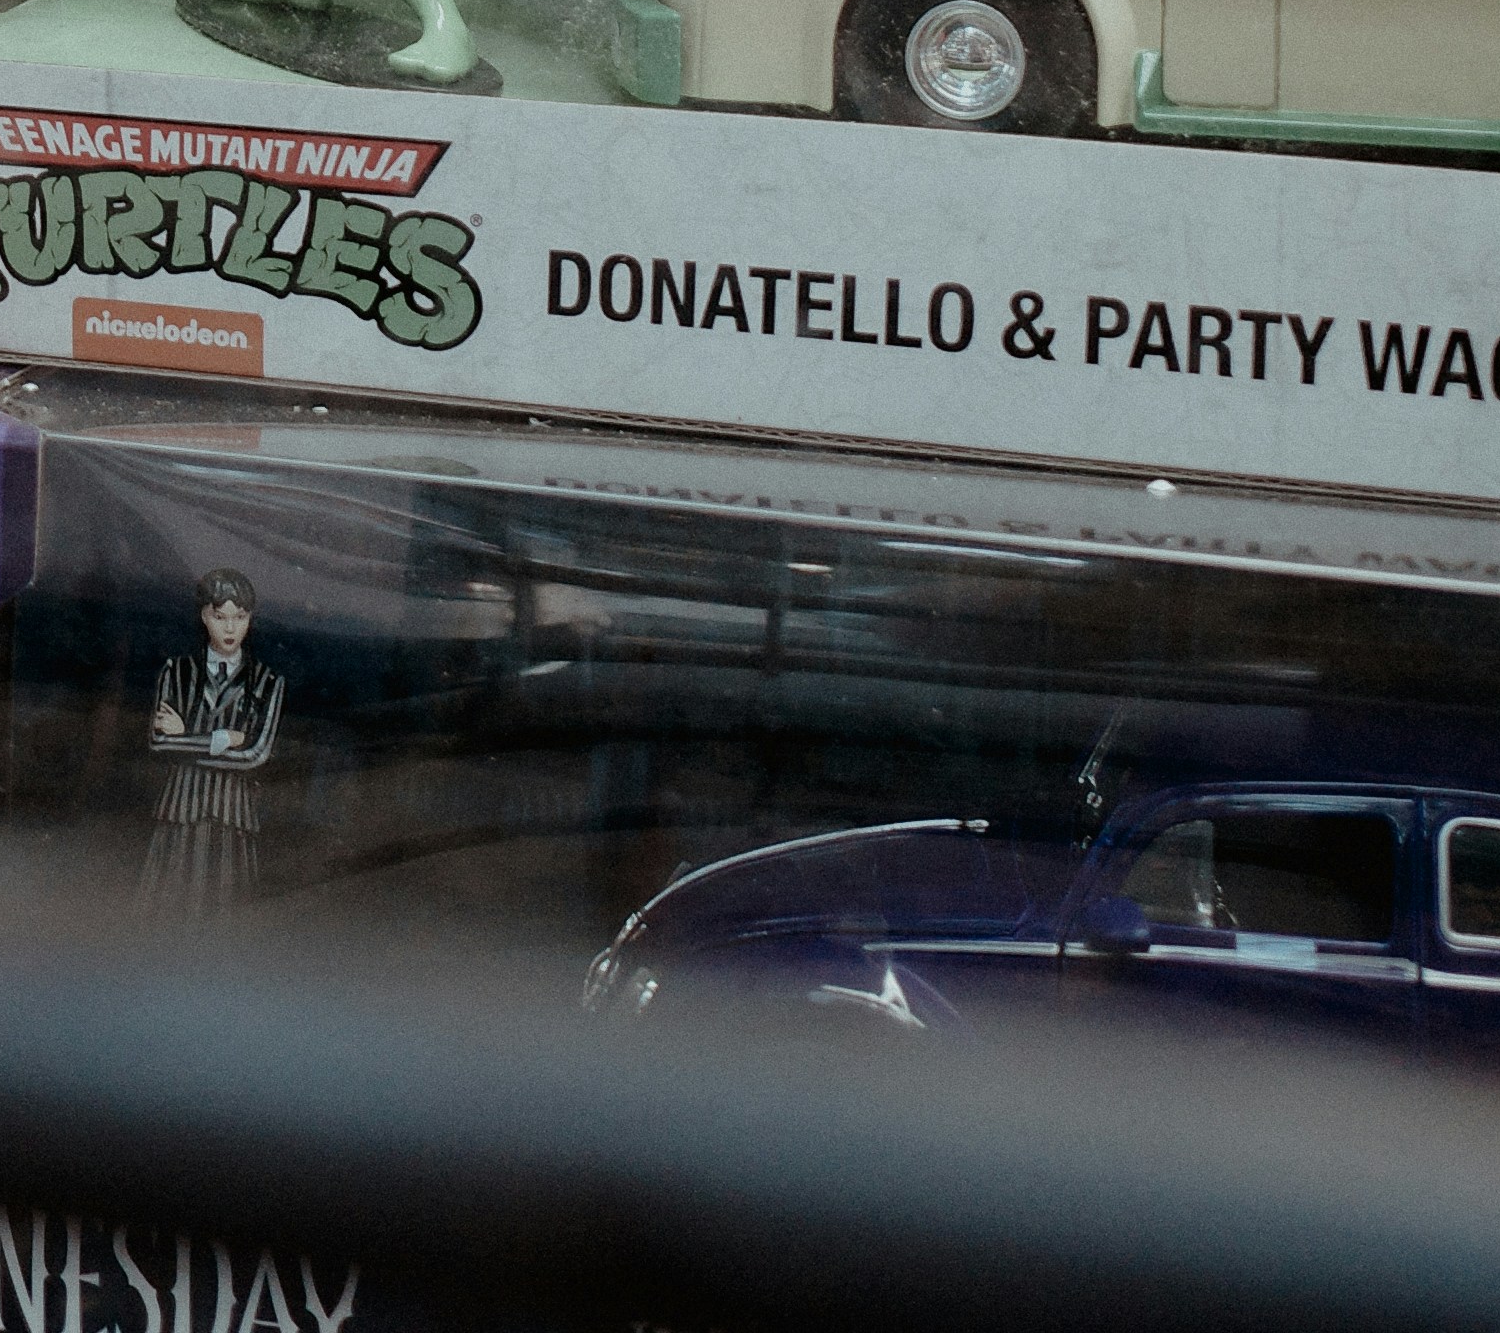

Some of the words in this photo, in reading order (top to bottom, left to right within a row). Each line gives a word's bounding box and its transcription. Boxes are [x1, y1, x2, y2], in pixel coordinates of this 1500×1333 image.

[149, 130, 296, 174] MUTANT
[297, 141, 419, 185] NINJA
[84, 314, 250, 350] nickelodeon
[546, 248, 976, 354] DONATELLO
[1002, 289, 1057, 362] &
[1083, 296, 1335, 386] PARTY
